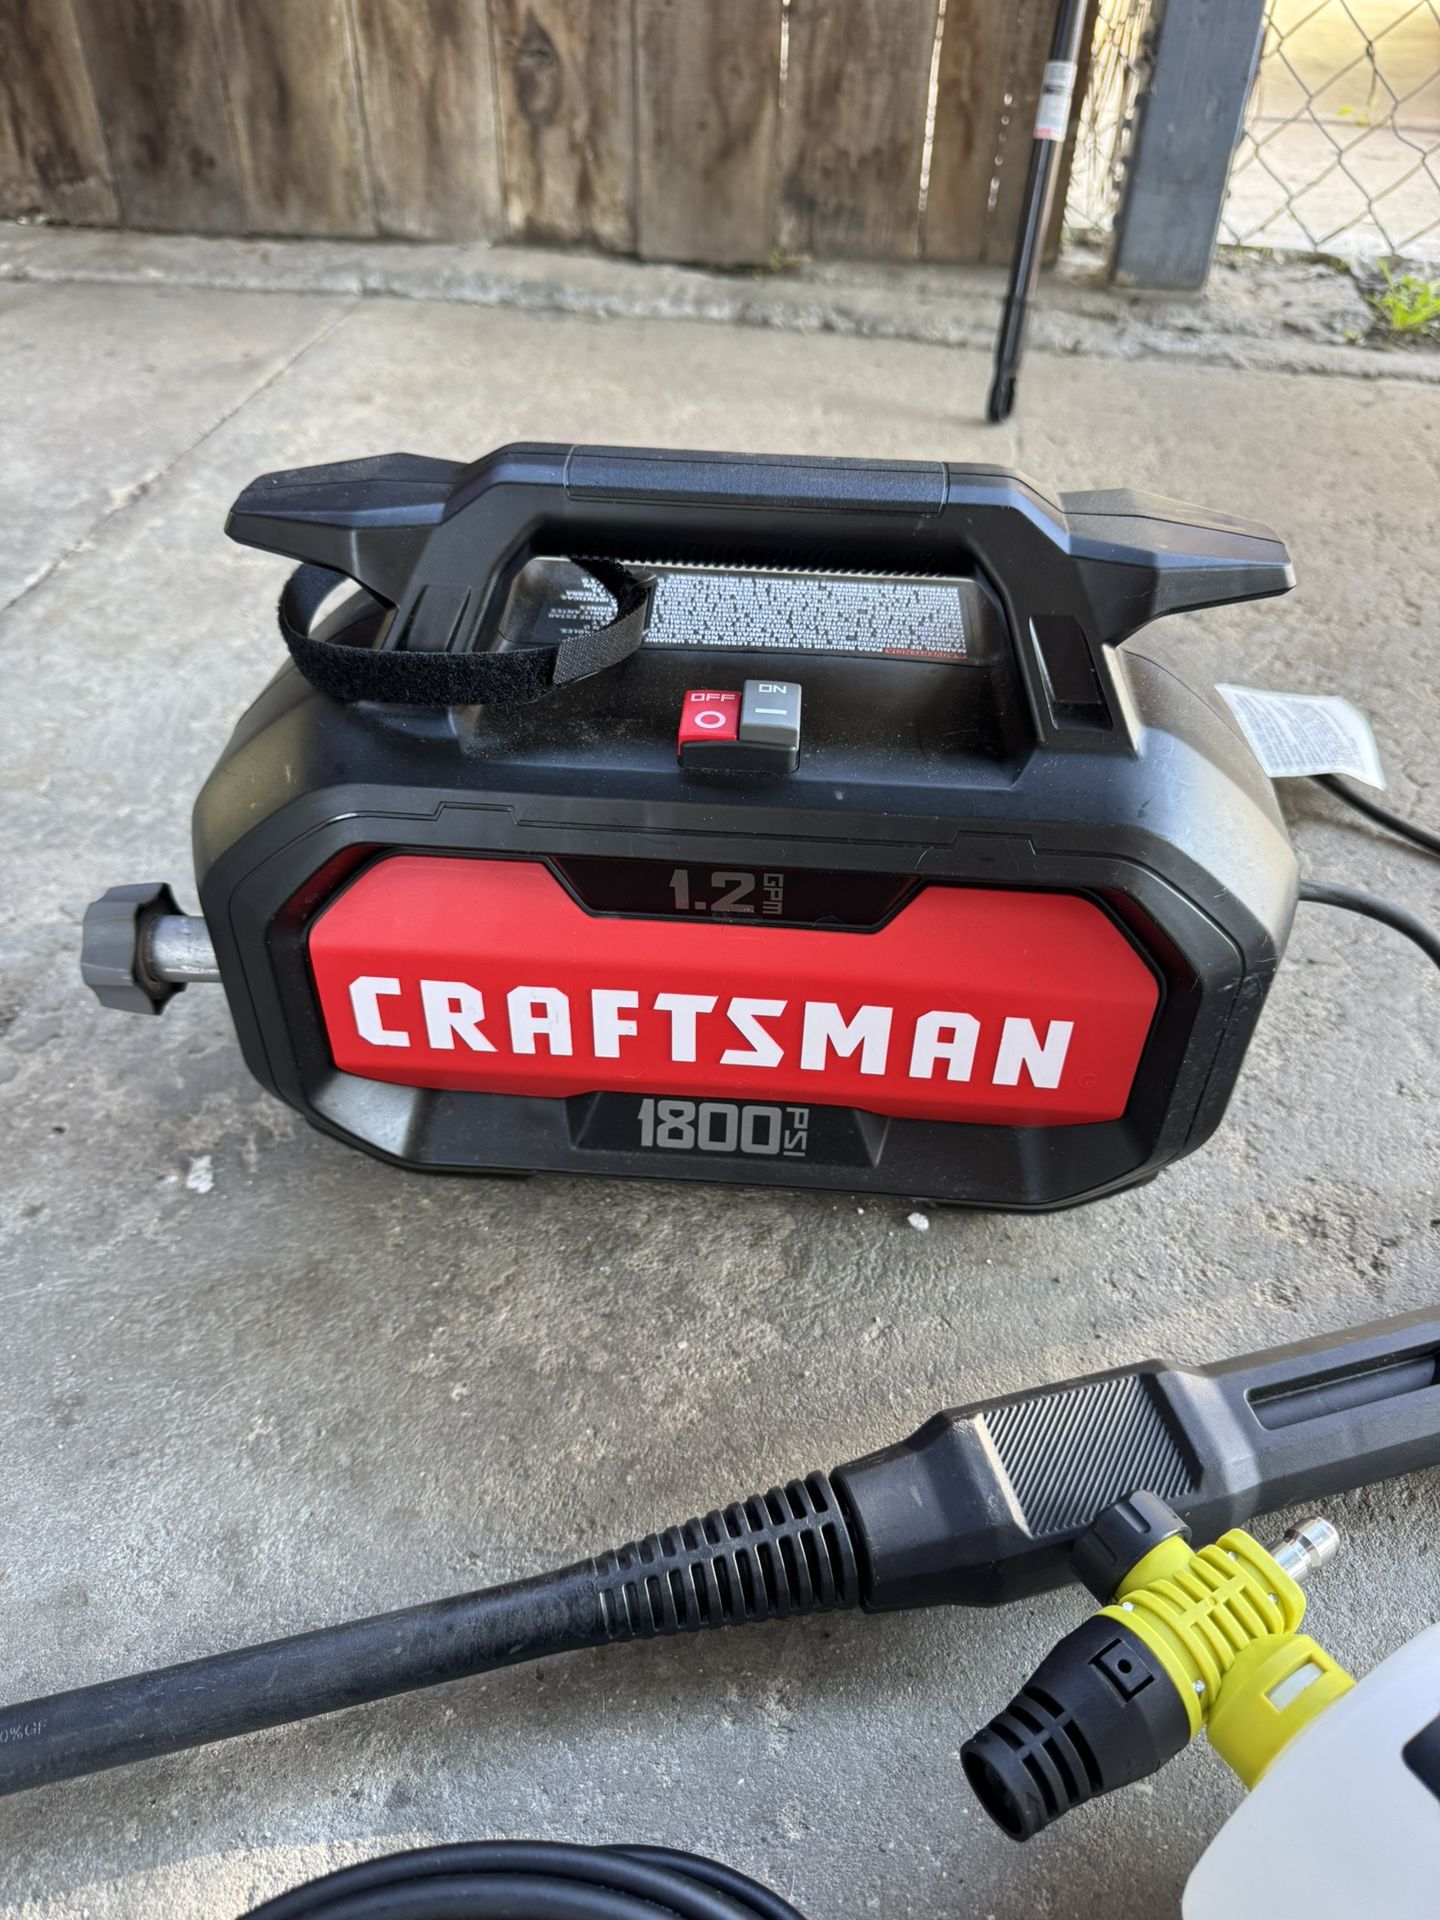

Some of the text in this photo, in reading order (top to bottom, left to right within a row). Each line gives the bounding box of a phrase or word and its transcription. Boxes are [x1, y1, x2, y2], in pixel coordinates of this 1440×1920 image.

[691, 693, 735, 702] OFF
[759, 684, 787, 694] ON
[669, 869, 784, 915] 1.2 GPM
[349, 975, 1076, 1089] CRAFTSMAN
[637, 1098, 809, 1157] 1800 PSI
